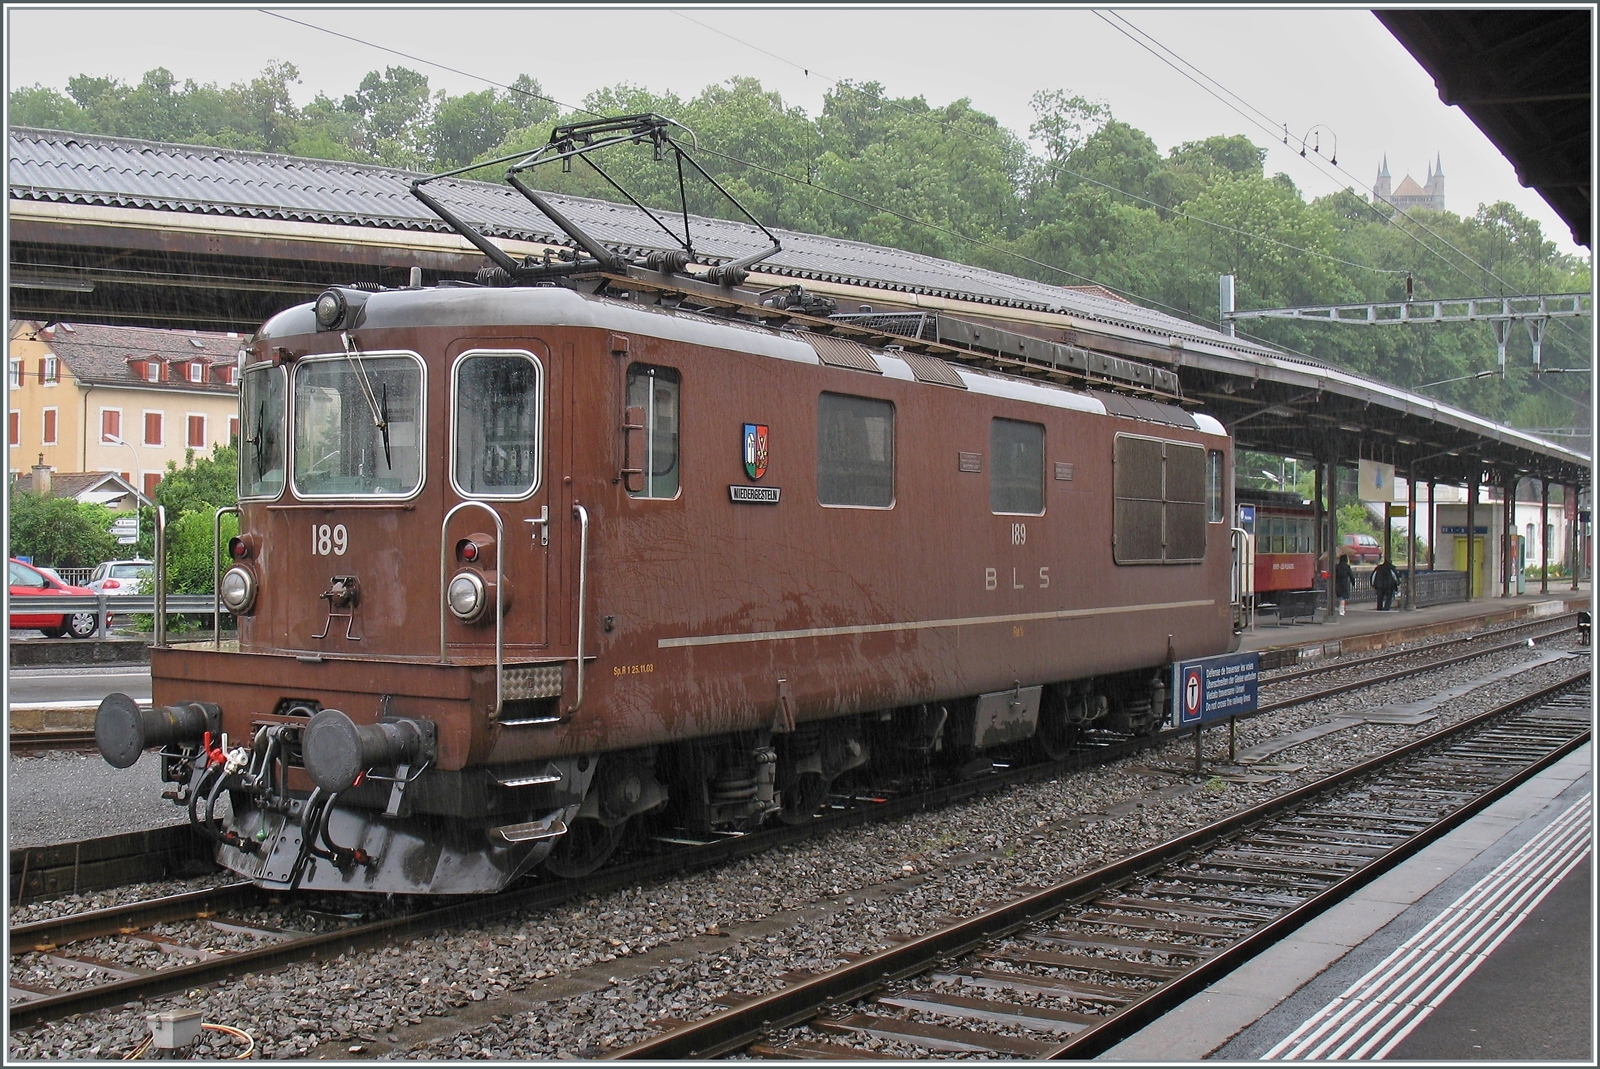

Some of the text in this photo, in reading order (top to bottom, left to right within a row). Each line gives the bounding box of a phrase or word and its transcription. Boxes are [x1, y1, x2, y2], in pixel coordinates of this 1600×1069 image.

[734, 488, 777, 500] NIEDERGESTELN
[312, 524, 348, 556] 189
[1011, 523, 1026, 545] 189
[631, 663, 654, 674] 25.11.03
[1221, 666, 1225, 675] de
[1226, 665, 1240, 674] traverser
[1246, 662, 1254, 670] voies
[1206, 702, 1211, 711] Do
[1217, 700, 1226, 709] cross
[1233, 696, 1243, 705] railway
[1243, 694, 1251, 703] lines
